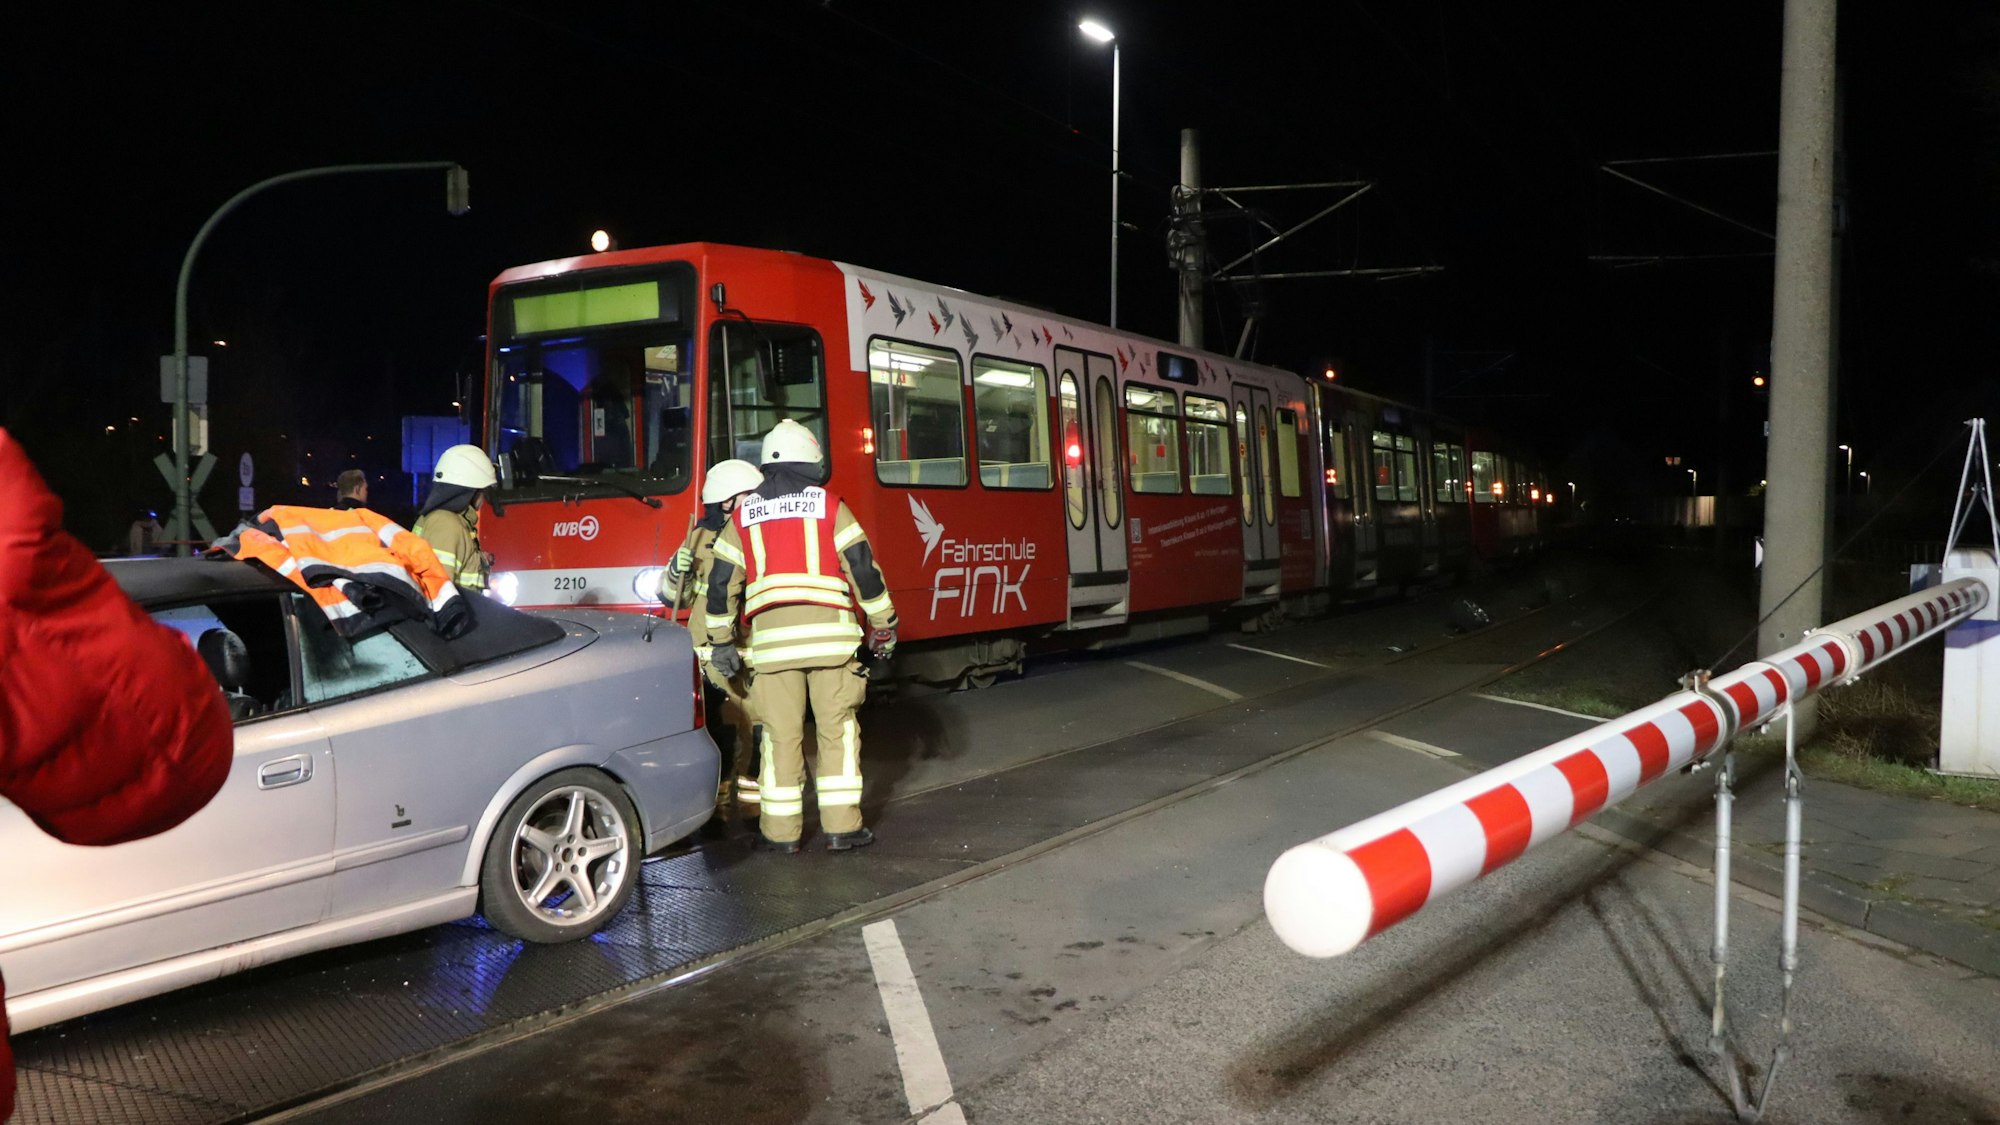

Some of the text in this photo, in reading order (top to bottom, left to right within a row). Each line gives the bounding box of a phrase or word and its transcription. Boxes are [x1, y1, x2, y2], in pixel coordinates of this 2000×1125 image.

[749, 504, 769, 519] BRL
[779, 501, 816, 514] HLF20
[552, 521, 579, 537] KVB
[941, 537, 1036, 563] Fahrschule
[554, 576, 587, 590] 2210
